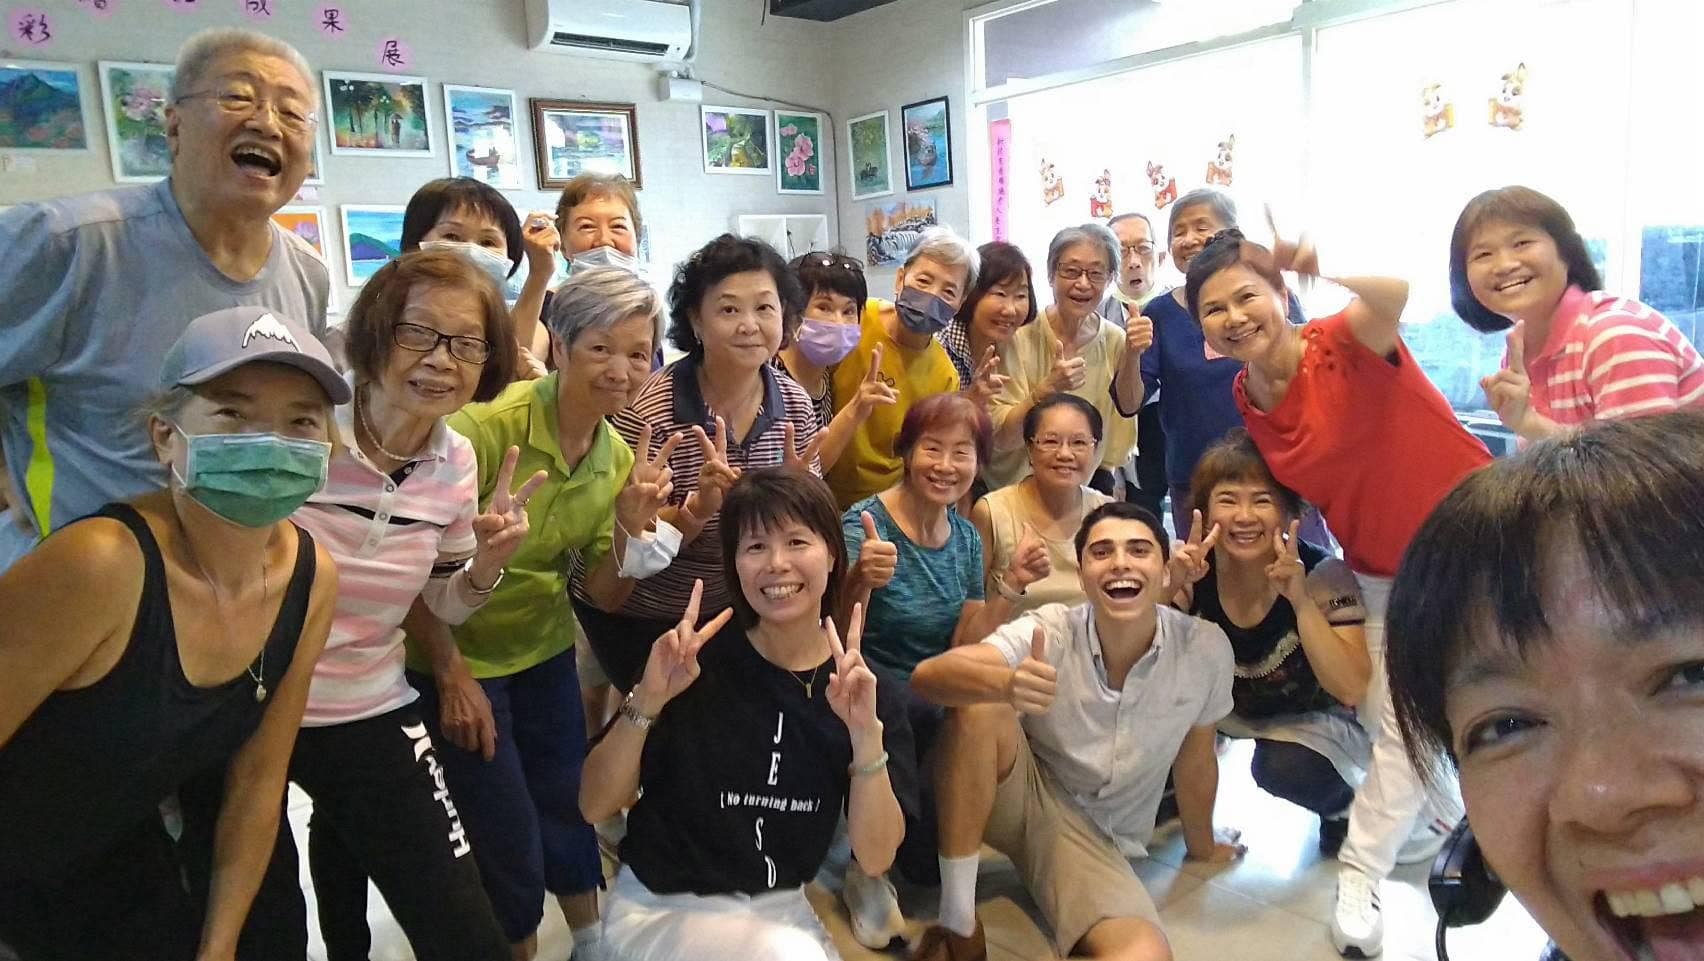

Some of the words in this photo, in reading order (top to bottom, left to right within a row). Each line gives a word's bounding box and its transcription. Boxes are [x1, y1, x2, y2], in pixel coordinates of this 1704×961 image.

[321, 8, 344, 33] 果
[381, 39, 405, 67] 展
[425, 754, 471, 858] Hurley
[743, 791, 788, 812] turning
